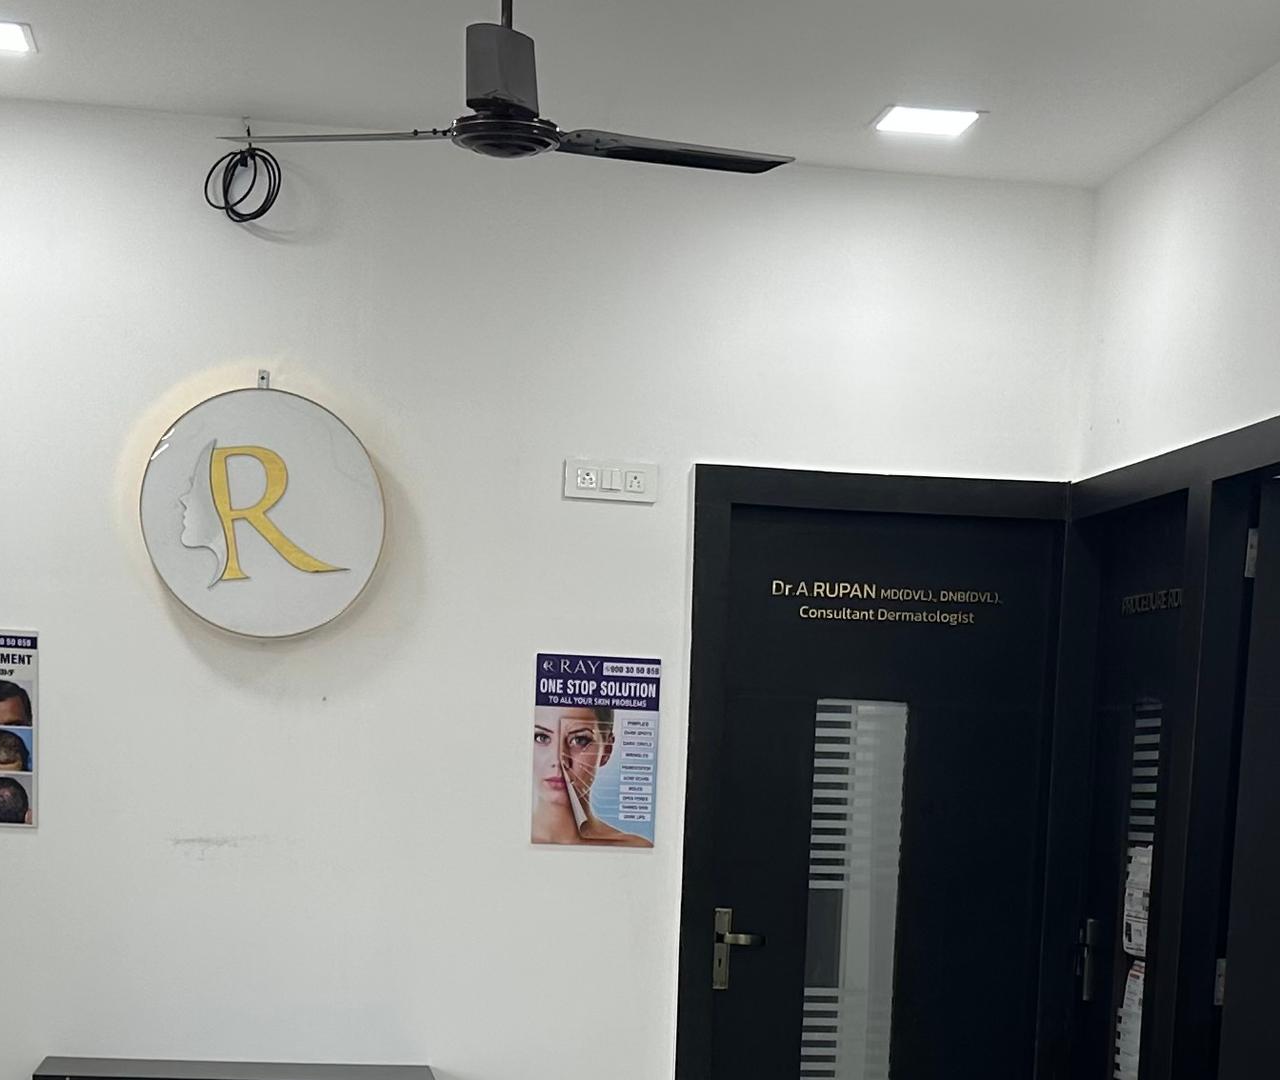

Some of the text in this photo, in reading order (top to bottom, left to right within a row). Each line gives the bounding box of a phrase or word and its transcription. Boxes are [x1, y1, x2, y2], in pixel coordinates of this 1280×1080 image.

[210, 445, 350, 581] R
[800, 605, 975, 625] Consultant Dermatologist
[560, 659, 600, 674] RAY
[540, 678, 656, 698] ONE STOP SOLUTION
[548, 695, 647, 708] TO ALL YOUR SKIN PROBLEMS
